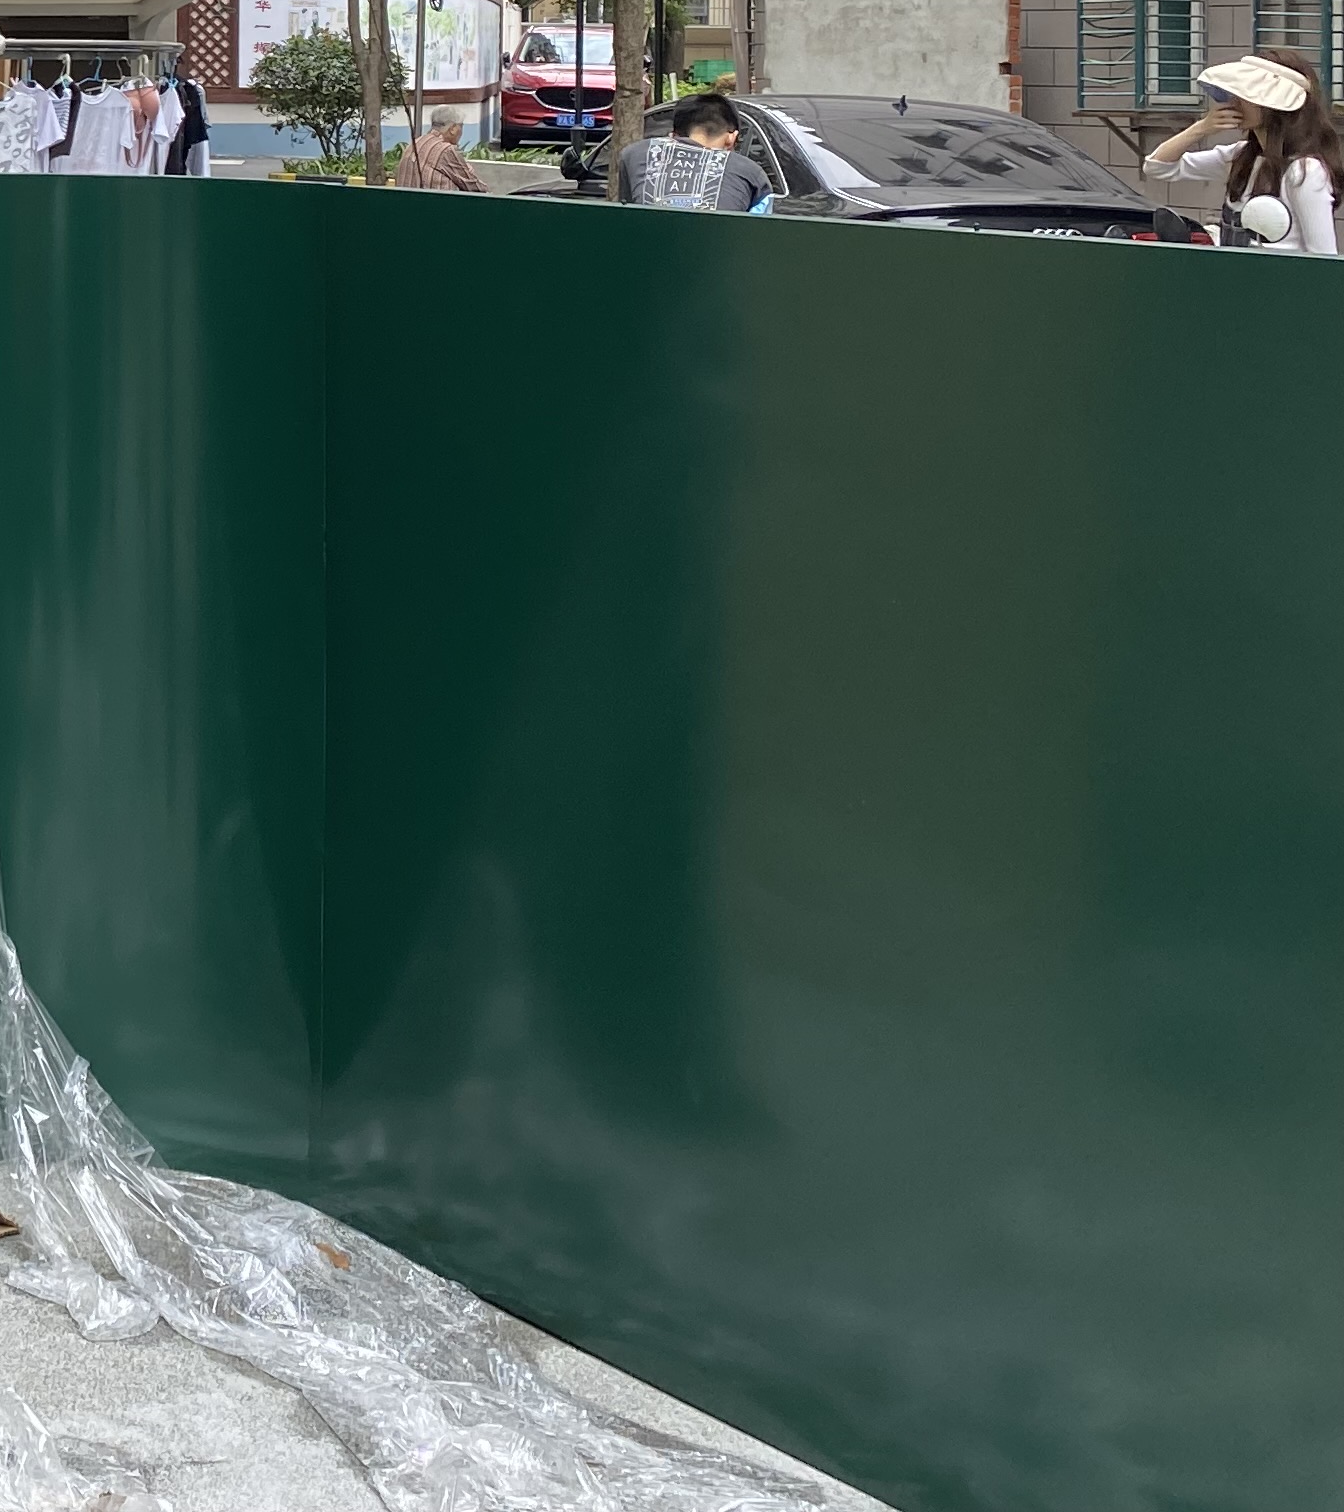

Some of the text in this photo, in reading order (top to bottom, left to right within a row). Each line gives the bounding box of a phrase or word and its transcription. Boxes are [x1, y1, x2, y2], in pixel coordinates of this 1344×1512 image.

[673, 159, 696, 169] AN
[670, 168, 693, 179] GH
[669, 180, 688, 192] AI
